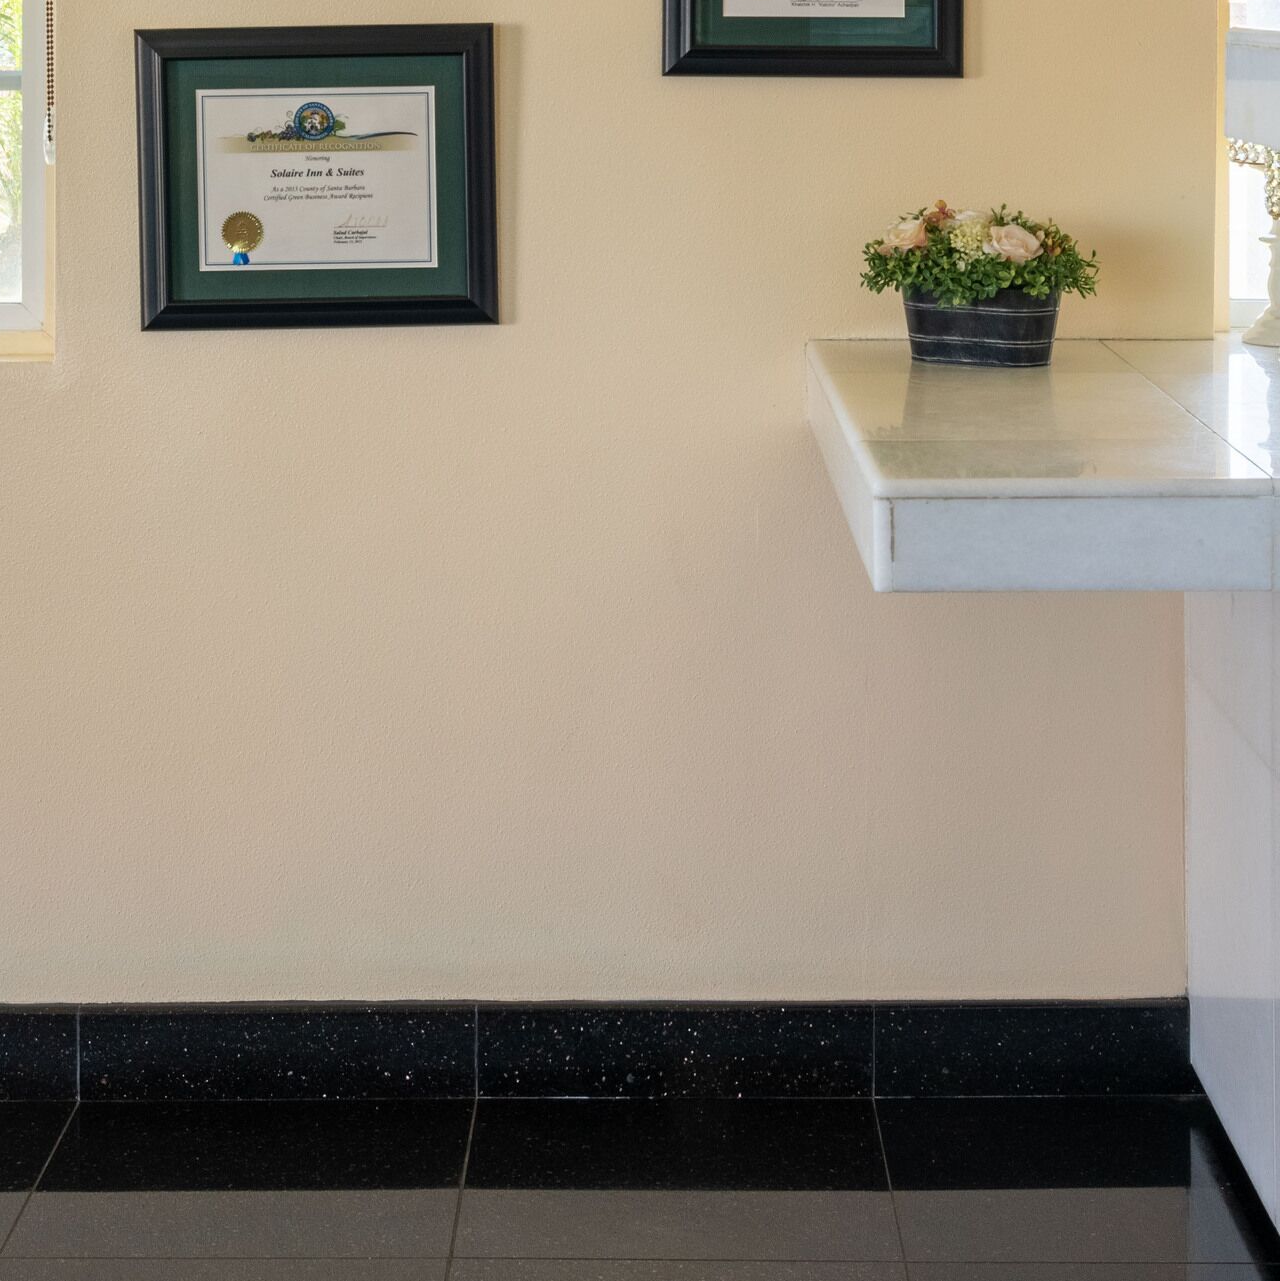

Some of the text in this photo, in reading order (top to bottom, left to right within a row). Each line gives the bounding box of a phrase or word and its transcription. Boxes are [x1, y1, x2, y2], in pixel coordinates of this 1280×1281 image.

[270, 168, 364, 178] Solaire Inn & Suites
